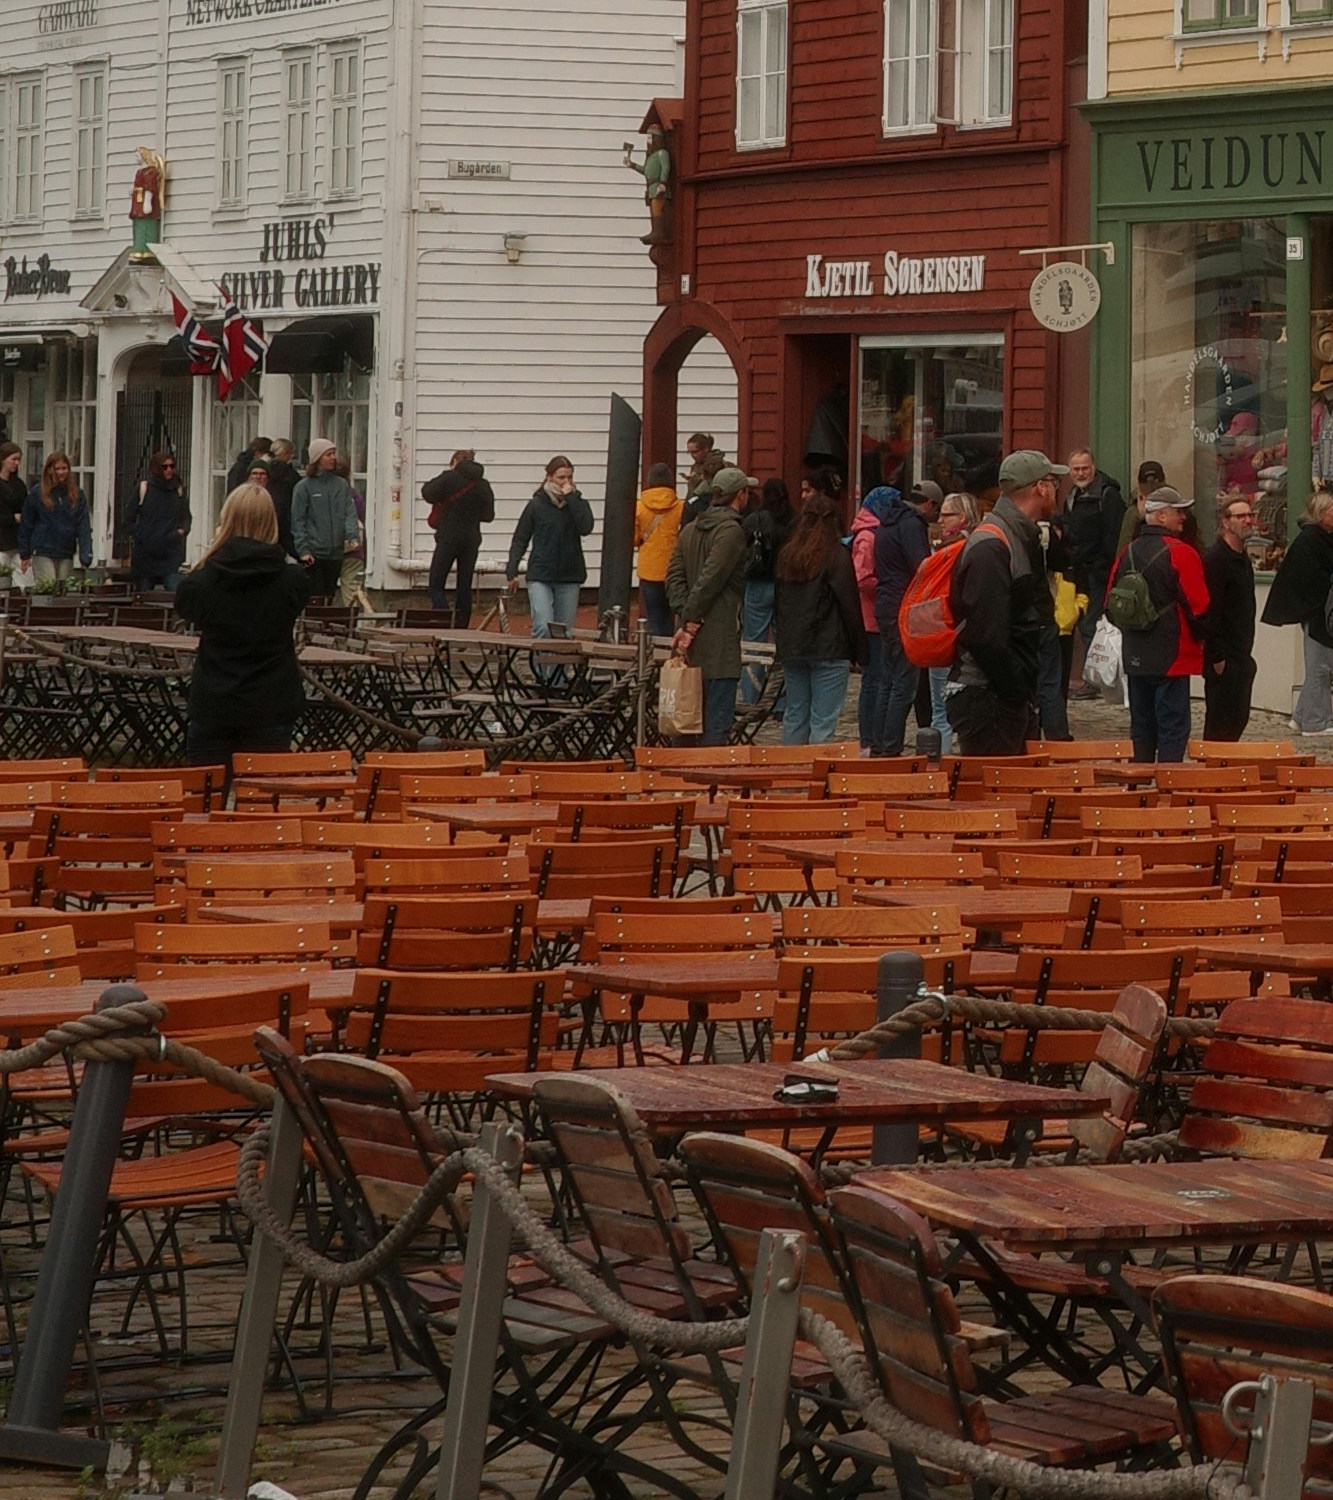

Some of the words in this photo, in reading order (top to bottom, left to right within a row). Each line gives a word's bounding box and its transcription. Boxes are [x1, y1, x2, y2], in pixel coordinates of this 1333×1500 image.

[260, 213, 334, 263] JUHLS'
[1288, 243, 1298, 254] 35
[218, 269, 285, 310] SILVER
[294, 262, 381, 307] GALLERY
[805, 254, 873, 297] KJETIL
[884, 251, 986, 297] SØRENSEN
[1044, 312, 1088, 328] SCHJØTT
